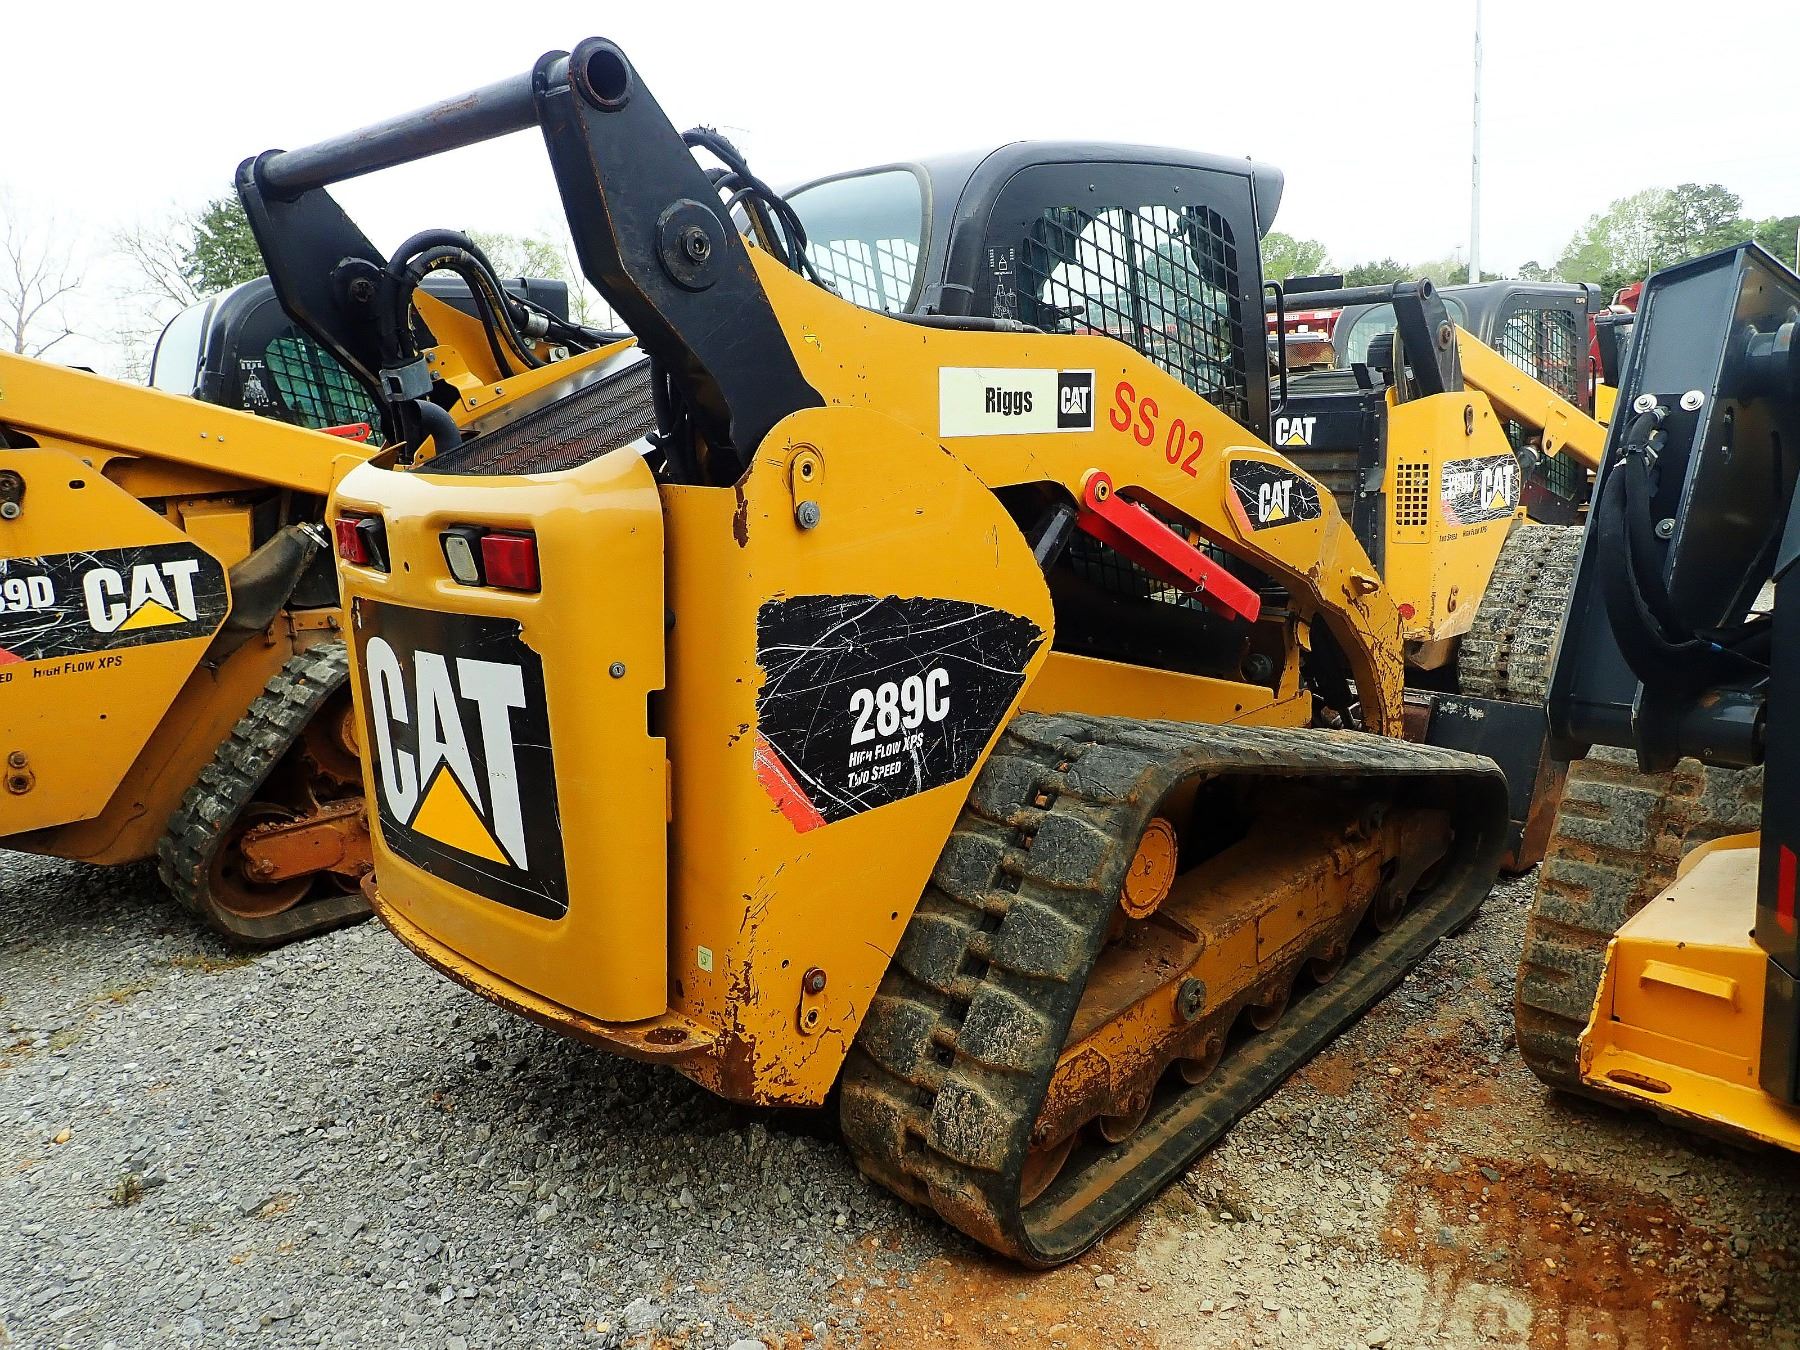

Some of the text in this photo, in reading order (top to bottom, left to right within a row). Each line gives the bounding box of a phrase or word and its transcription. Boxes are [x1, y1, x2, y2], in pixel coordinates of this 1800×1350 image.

[985, 386, 1091, 416] Riggs CAT
[1109, 382, 1204, 478] SS 02
[1275, 417, 1317, 445] CAT
[1259, 480, 1293, 523] CAT
[1481, 465, 1512, 509] CAT
[83, 559, 199, 632] CAT
[64, 661, 95, 673] FLOW
[98, 656, 122, 669] XPS
[850, 669, 949, 745] 289C
[366, 637, 528, 871] CAT
[875, 741, 901, 759] FLOW
[902, 732, 923, 751] XPS
[848, 761, 901, 788] TWO SPEED
